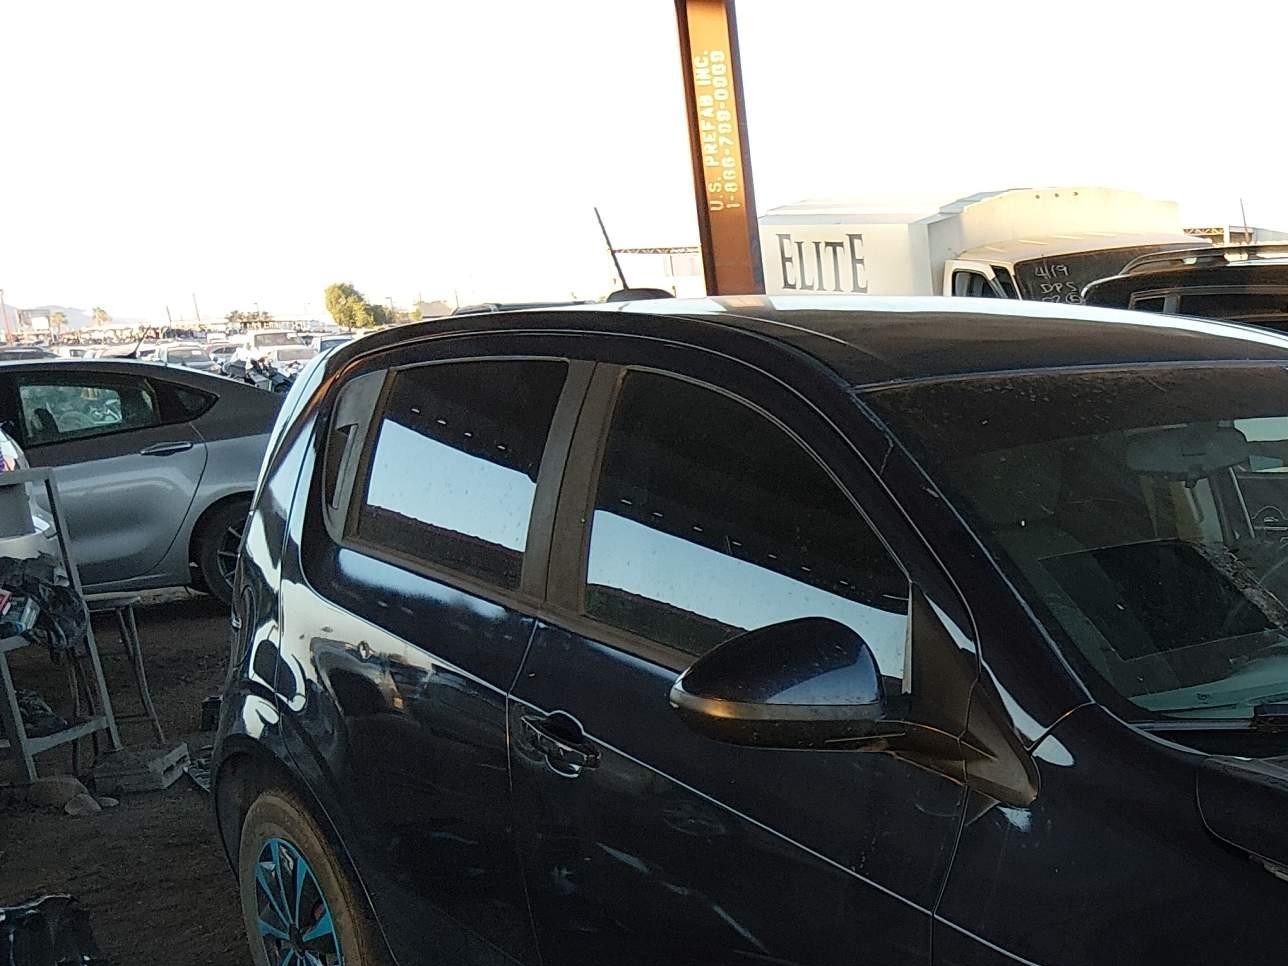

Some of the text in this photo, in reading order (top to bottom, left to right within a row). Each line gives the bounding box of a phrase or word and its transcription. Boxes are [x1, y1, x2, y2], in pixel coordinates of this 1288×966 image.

[694, 50, 724, 211] U.S. PREFAB INC.
[775, 233, 868, 293] ELITE
